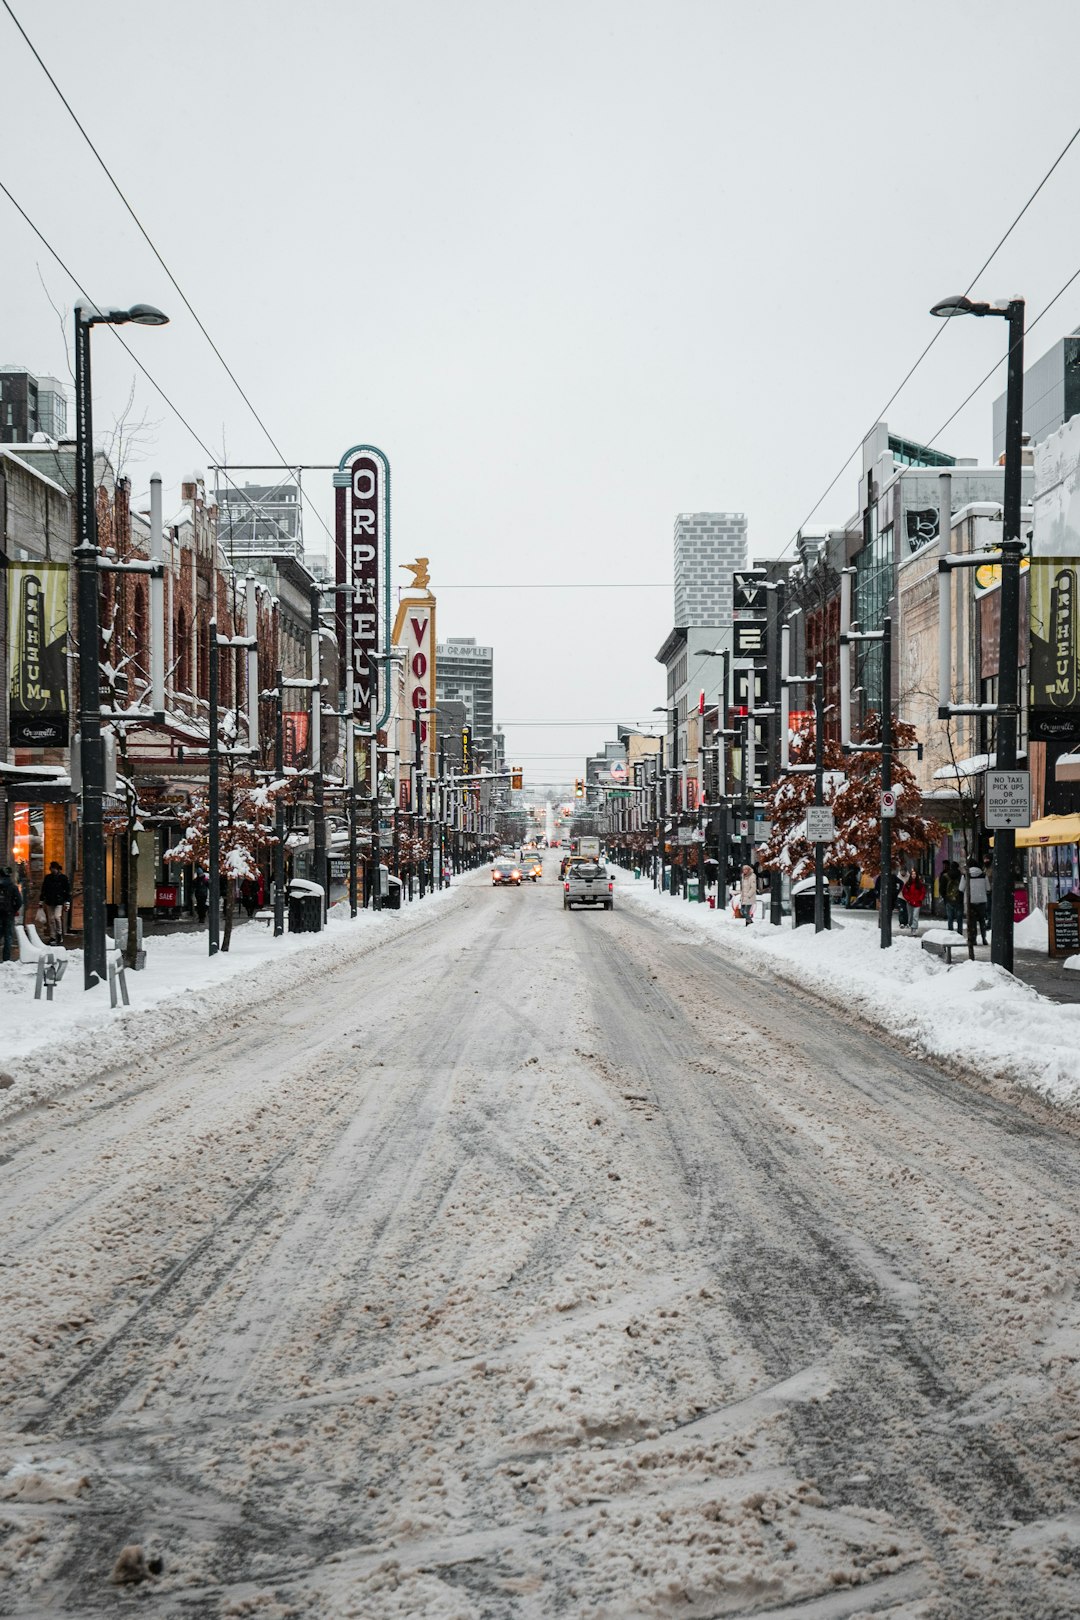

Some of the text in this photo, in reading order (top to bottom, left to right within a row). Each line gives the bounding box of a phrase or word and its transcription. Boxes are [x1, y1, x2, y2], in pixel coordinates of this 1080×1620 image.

[353, 468, 377, 709] ORPHEUM
[1056, 576, 1070, 694] ORPHEUM
[447, 646, 487, 656] GRANVILLE
